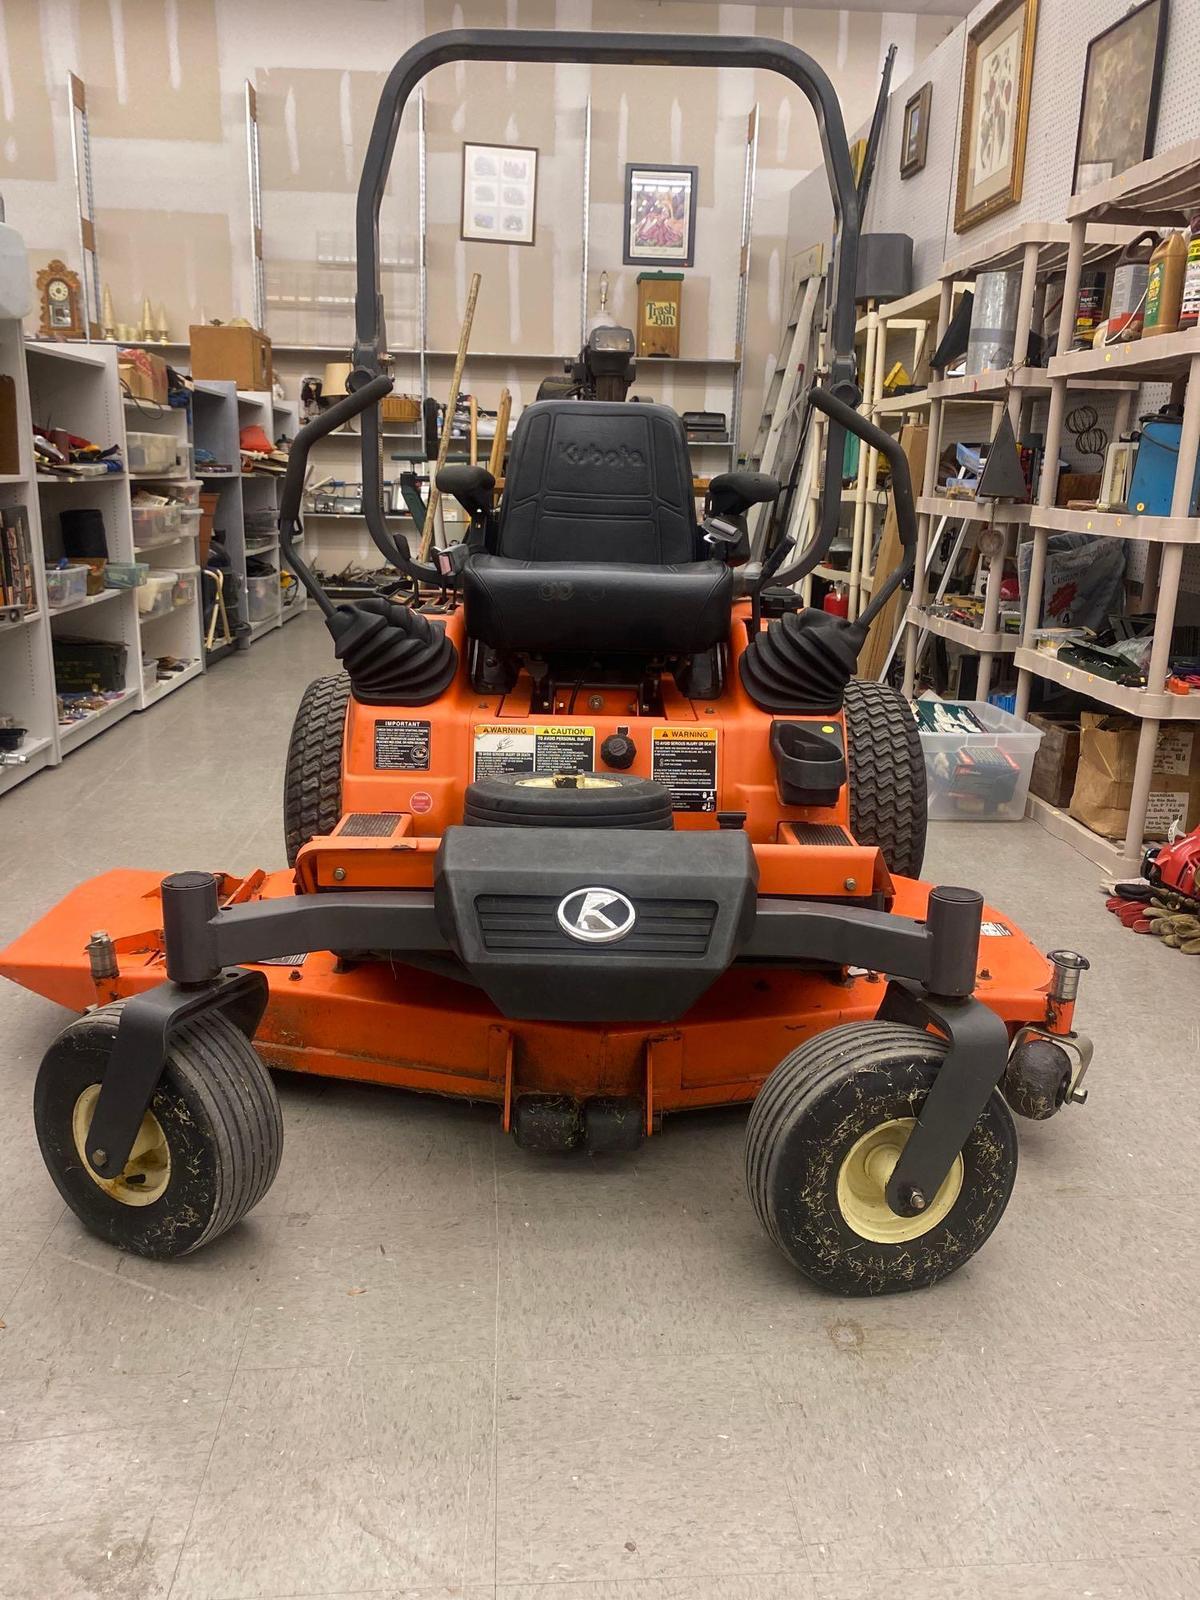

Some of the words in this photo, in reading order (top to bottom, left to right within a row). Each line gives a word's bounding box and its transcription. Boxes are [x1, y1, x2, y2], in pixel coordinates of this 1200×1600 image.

[646, 302, 676, 320] Trash
[558, 441, 648, 467] Kubota
[1062, 612, 1070, 624] 4
[489, 726, 527, 734] WARNING
[550, 727, 586, 735] CAUTION
[671, 730, 708, 738] WARNING
